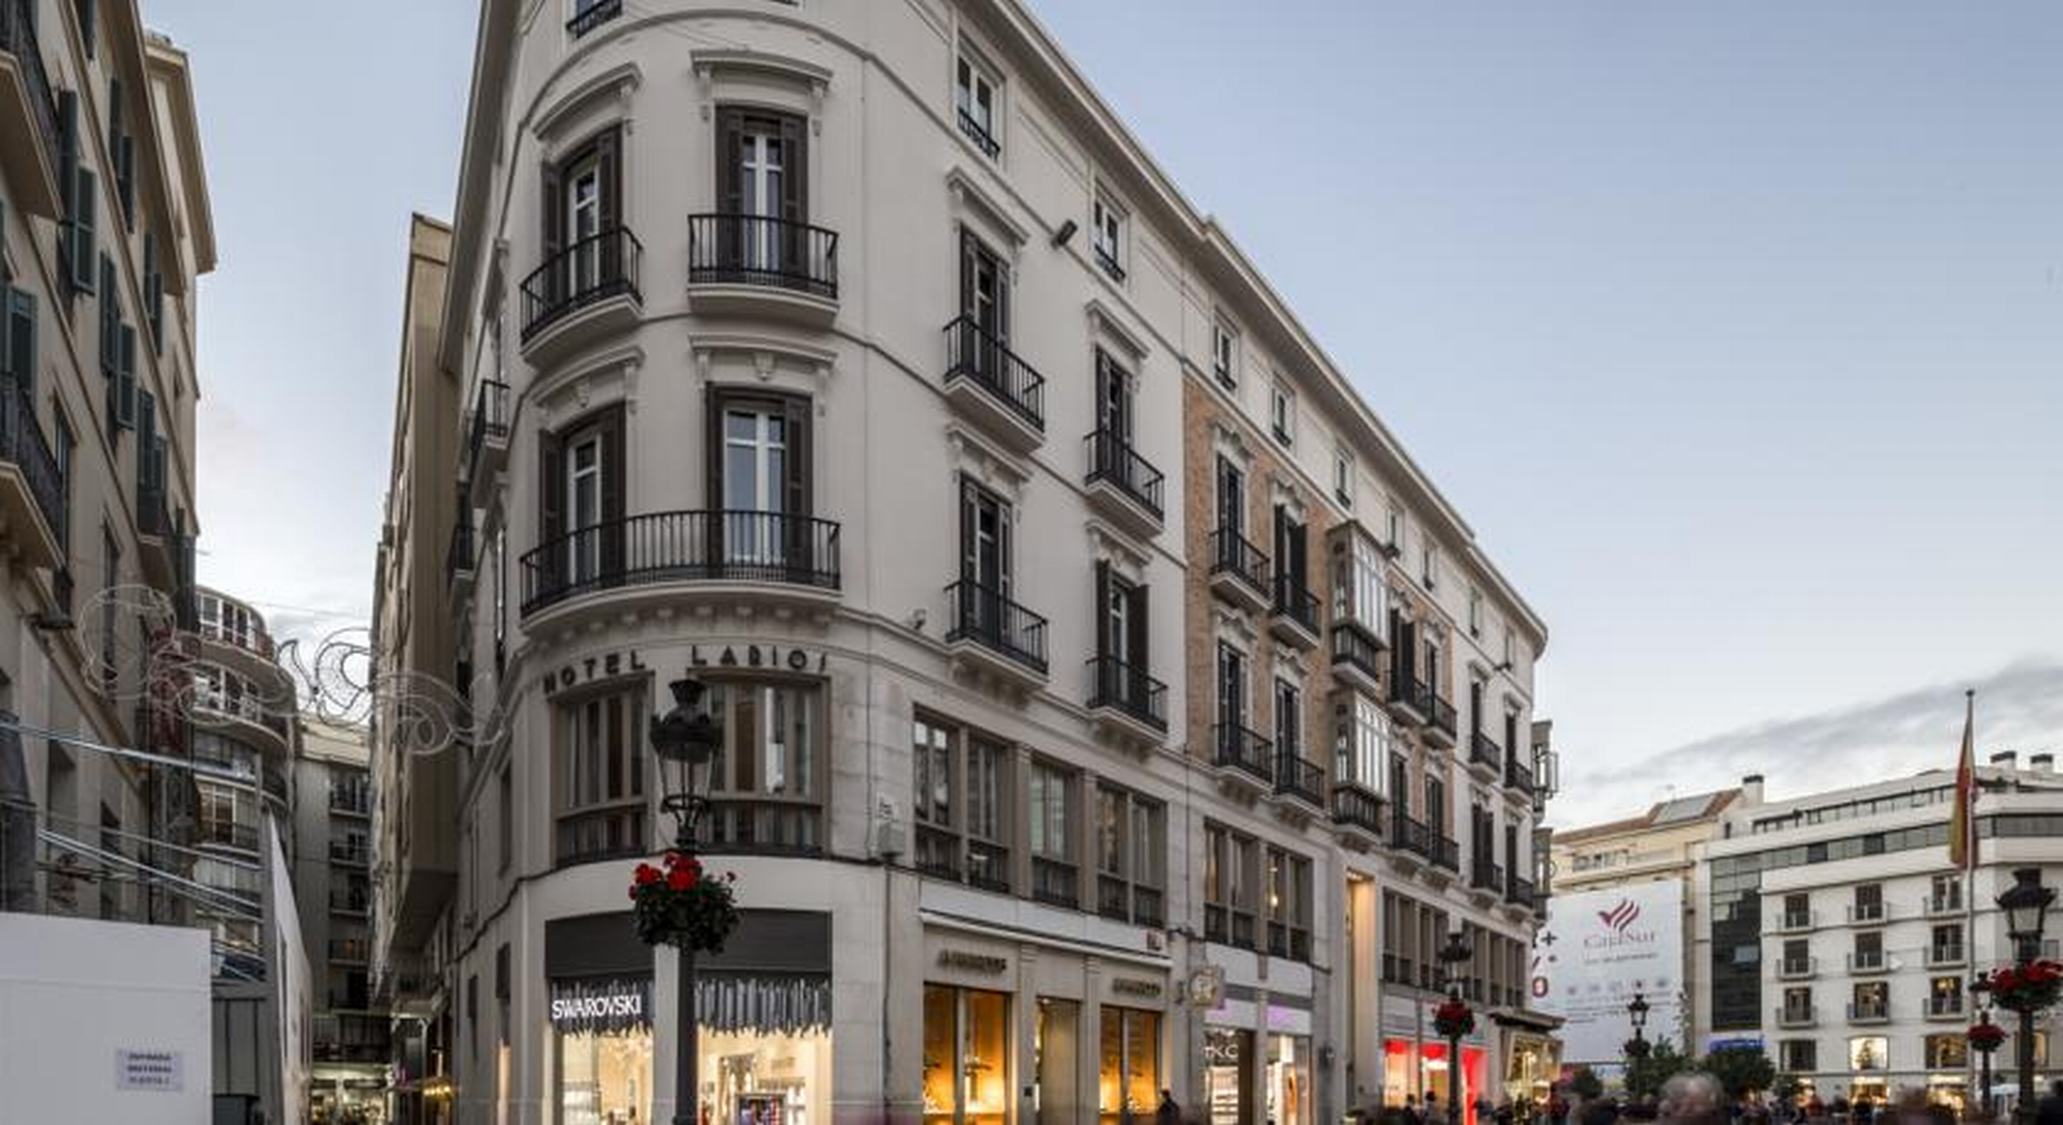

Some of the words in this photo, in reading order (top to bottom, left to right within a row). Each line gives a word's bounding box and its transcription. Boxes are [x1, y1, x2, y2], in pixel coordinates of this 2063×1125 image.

[543, 650, 645, 694] HOTEL
[691, 644, 827, 673] LARIOS
[551, 994, 642, 1020] SWAROVSKI
